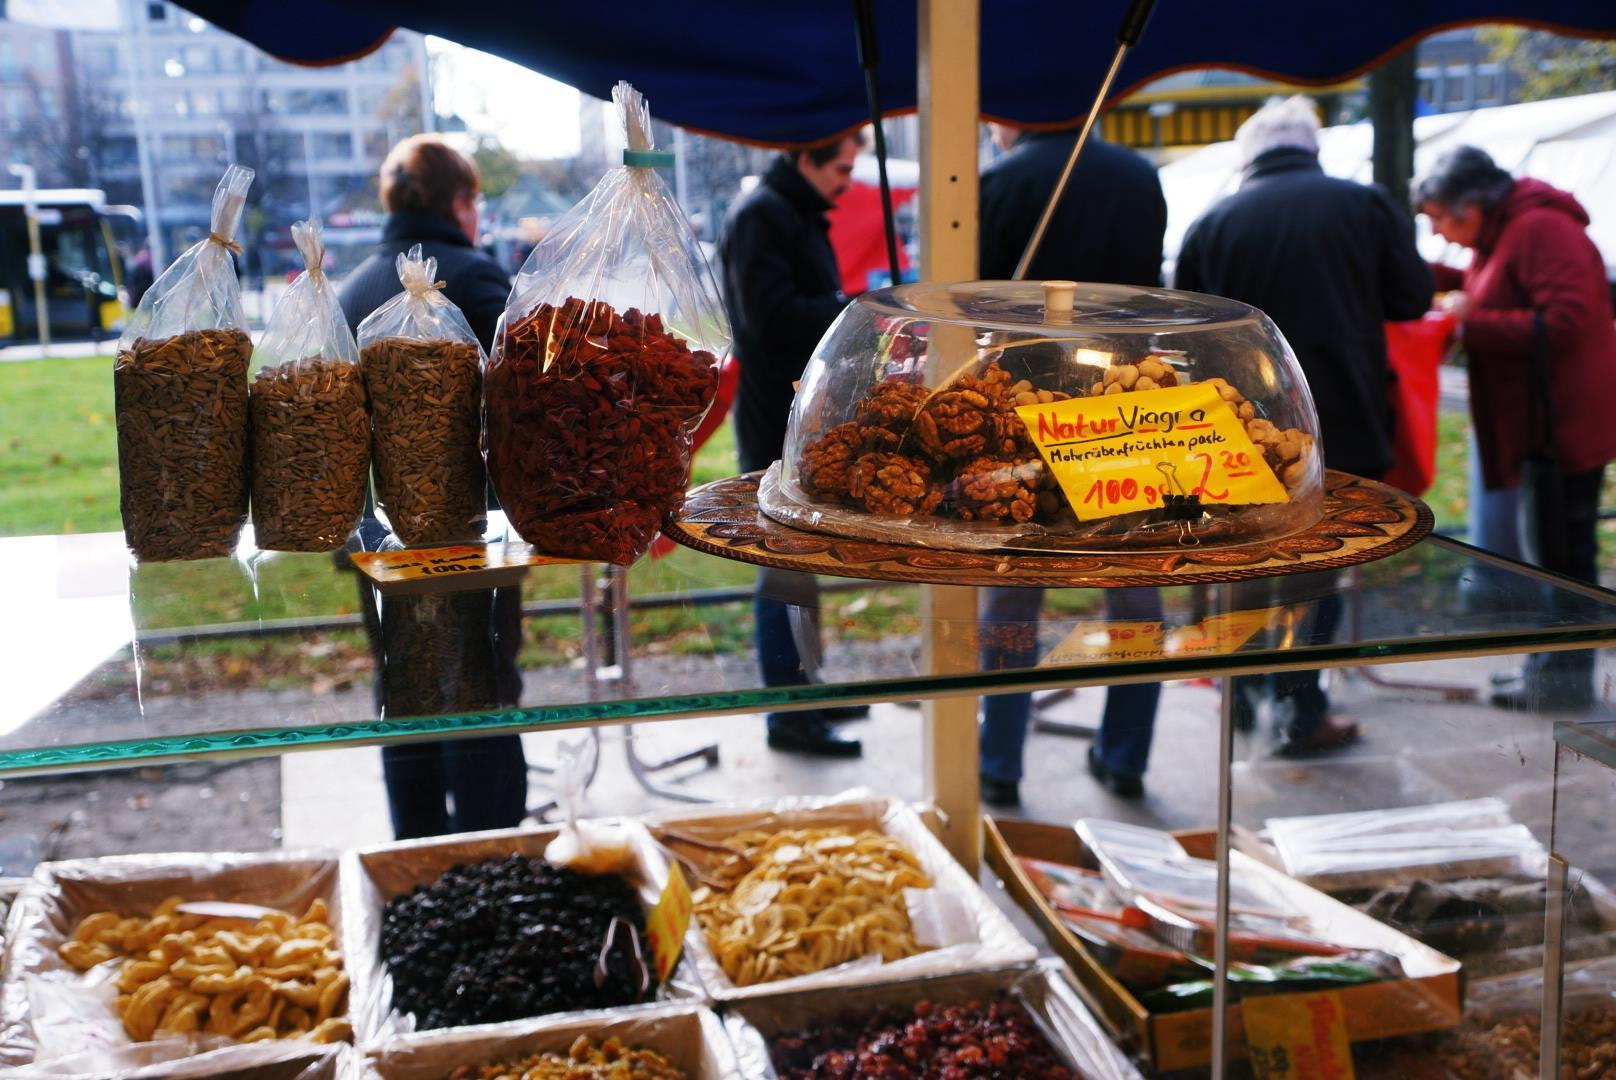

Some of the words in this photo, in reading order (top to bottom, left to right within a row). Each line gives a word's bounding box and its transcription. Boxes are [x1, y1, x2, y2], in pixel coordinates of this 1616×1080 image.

[1038, 411, 1120, 443] Natur
[1117, 405, 1206, 432] Viagra
[1083, 478, 1138, 510] 100
